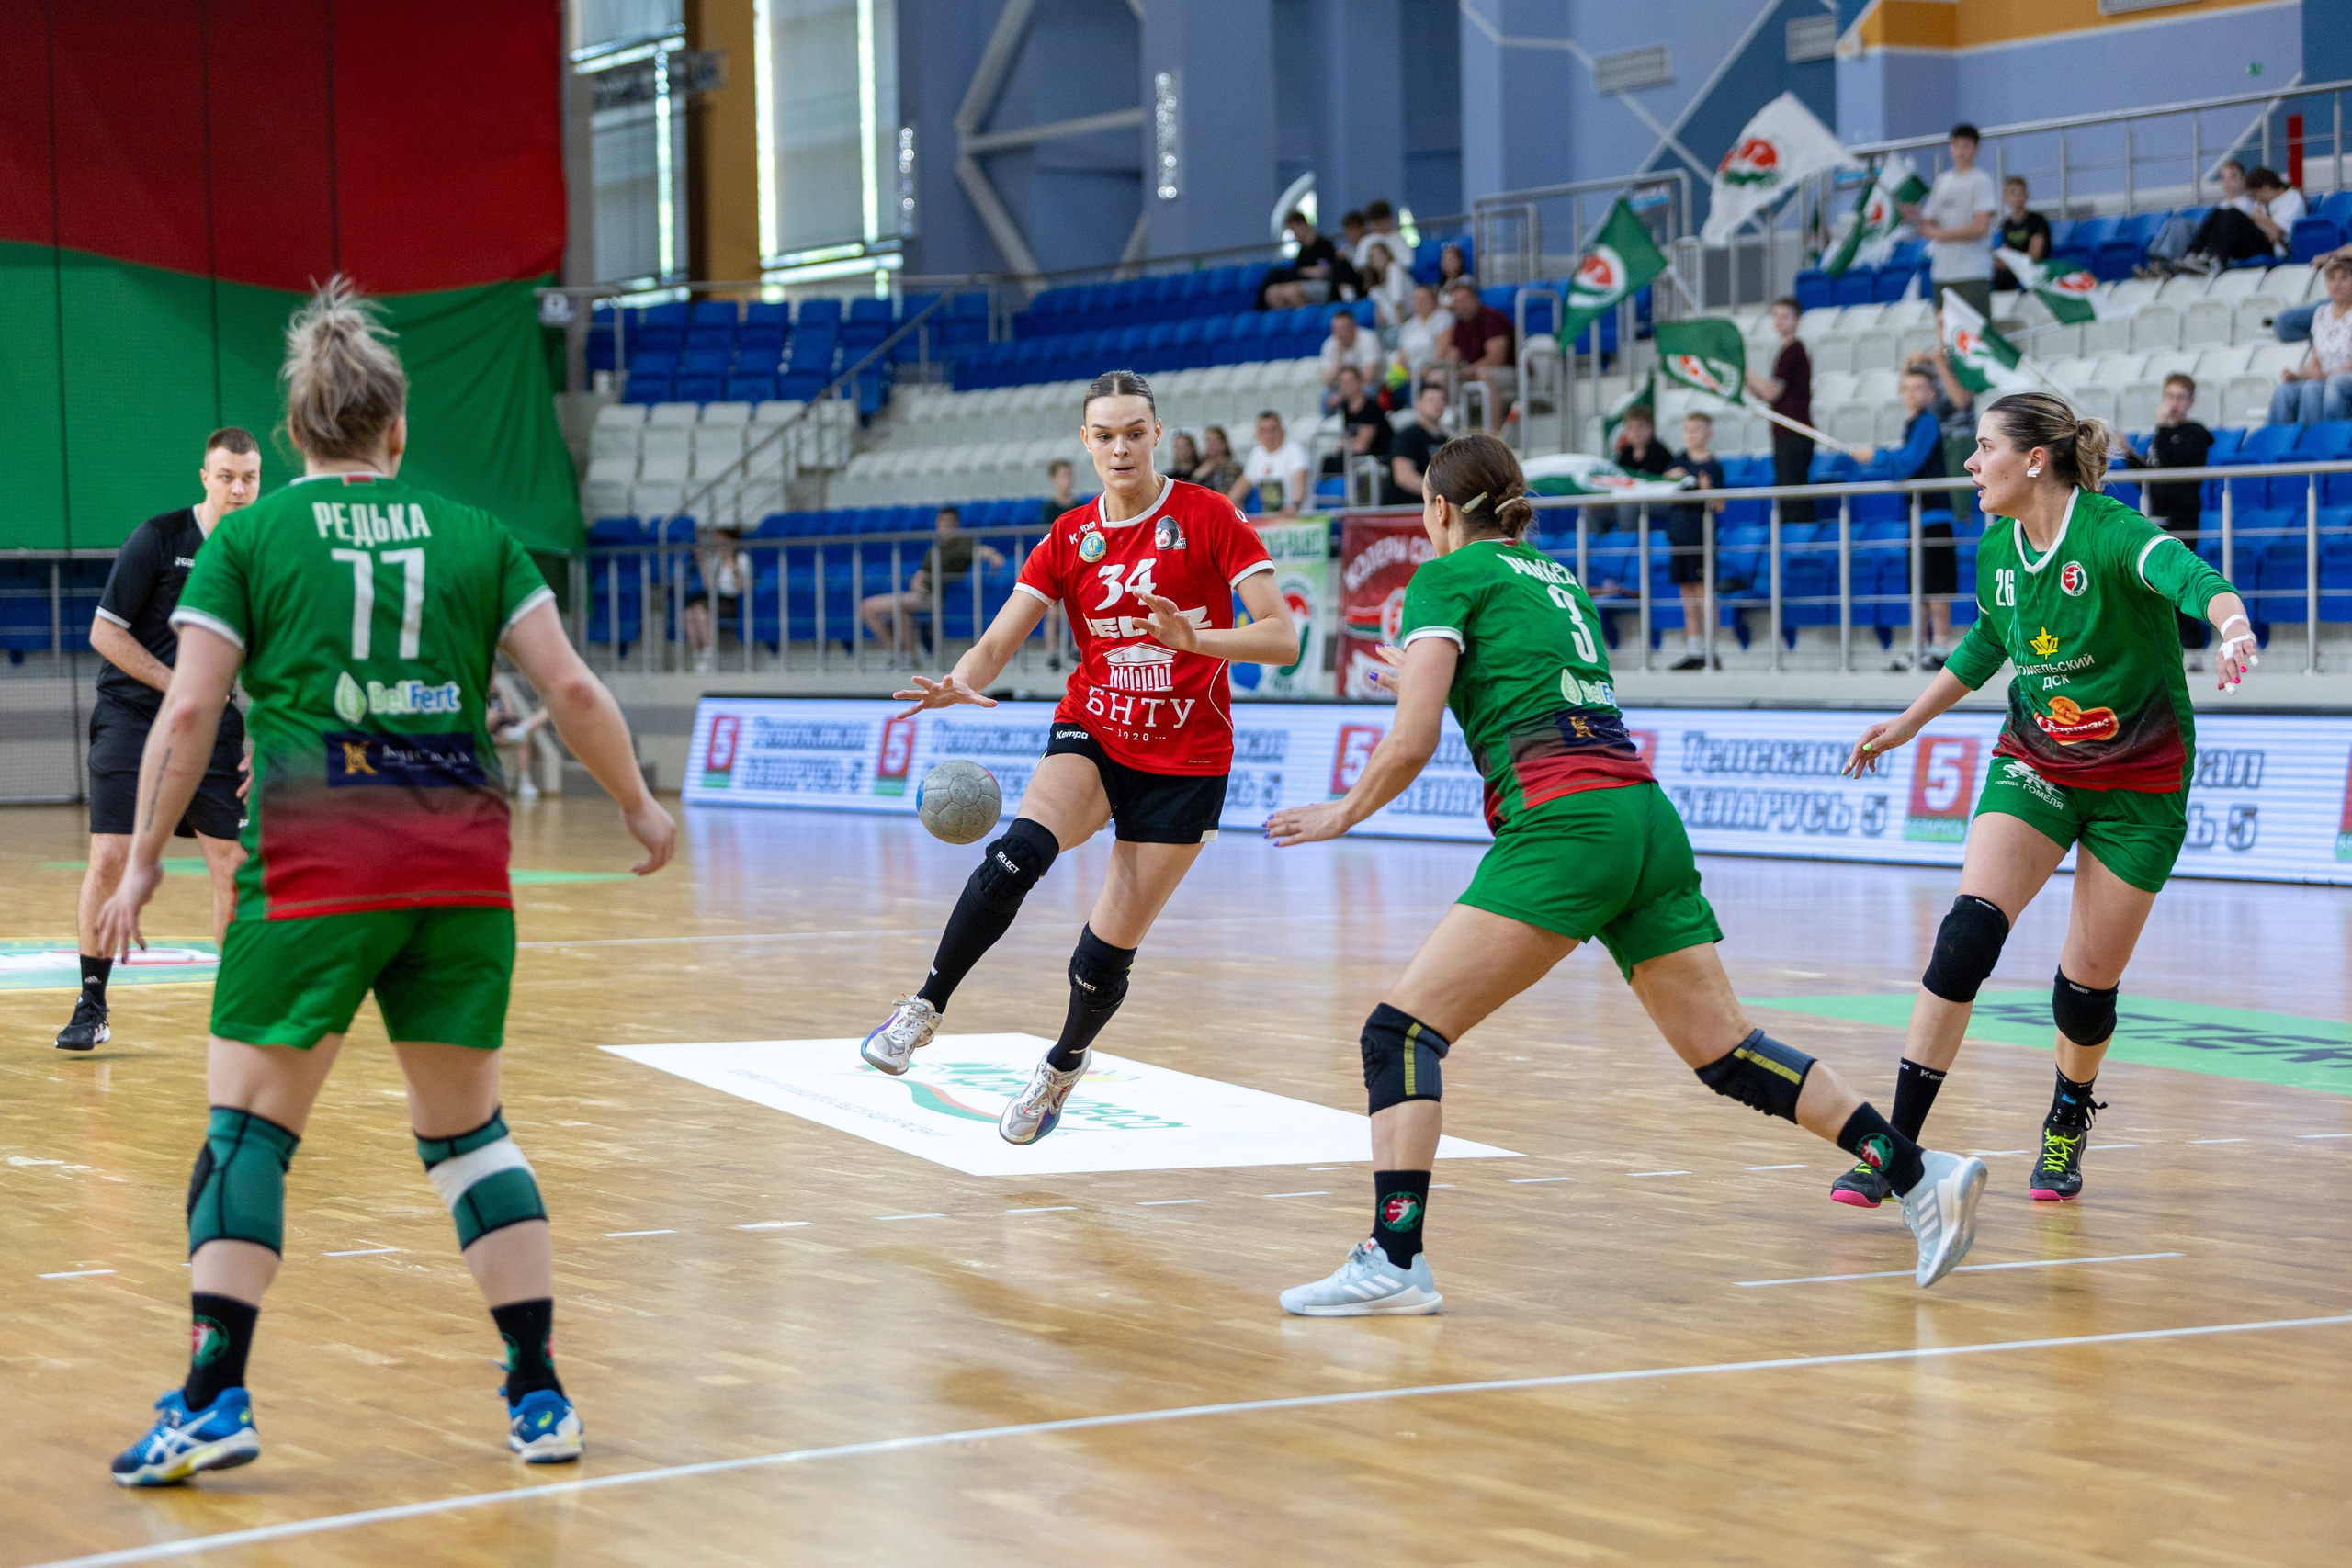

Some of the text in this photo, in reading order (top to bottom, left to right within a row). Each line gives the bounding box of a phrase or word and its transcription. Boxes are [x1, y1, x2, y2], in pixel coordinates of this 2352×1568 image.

[311, 501, 432, 548] РЕДЬКА
[1068, 520, 1096, 545] Kpa
[1094, 558, 1157, 611] 34
[1995, 569, 2015, 606] 26
[331, 547, 425, 660] 77
[1546, 584, 1598, 664] 3
[368, 680, 462, 715] BelFert
[2042, 674, 2071, 691] ДСК
[1085, 685, 1195, 728] БНТУ
[1056, 729, 1089, 740] Kempa
[1117, 728, 1149, 742] 1920
[1924, 742, 1963, 811] 5
[1860, 792, 1888, 837] 5
[2022, 783, 2064, 810] ГОМЕЛЯ
[2225, 803, 2258, 852] 5
[996, 851, 1021, 874] SELECT
[1075, 974, 1097, 992] SELECT
[2069, 982, 2091, 995] TORRES
